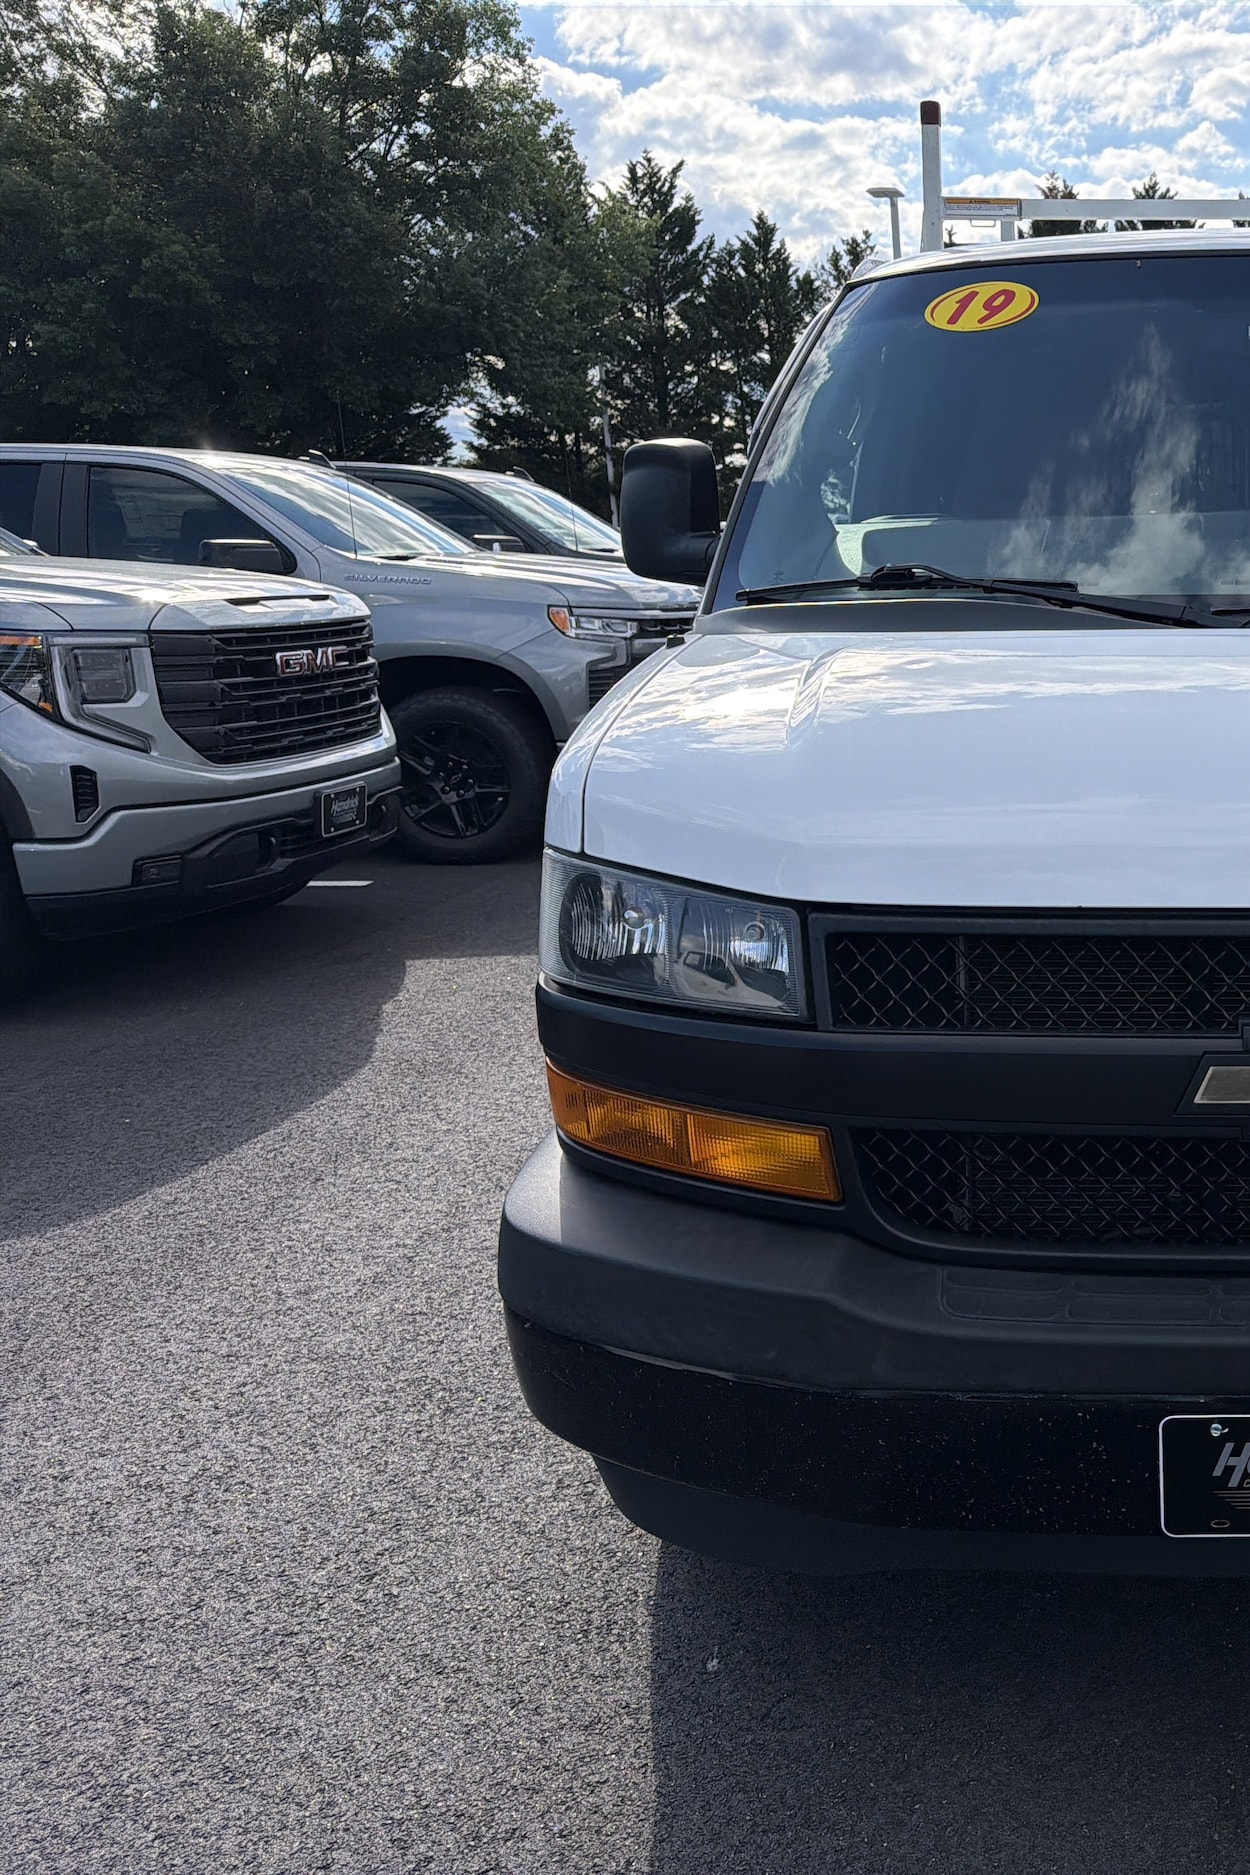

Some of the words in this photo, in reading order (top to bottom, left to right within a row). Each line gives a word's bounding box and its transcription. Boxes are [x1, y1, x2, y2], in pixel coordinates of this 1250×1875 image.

[946, 289, 1016, 325] 19
[343, 574, 432, 585] SILVERADO
[275, 645, 350, 677] GMC
